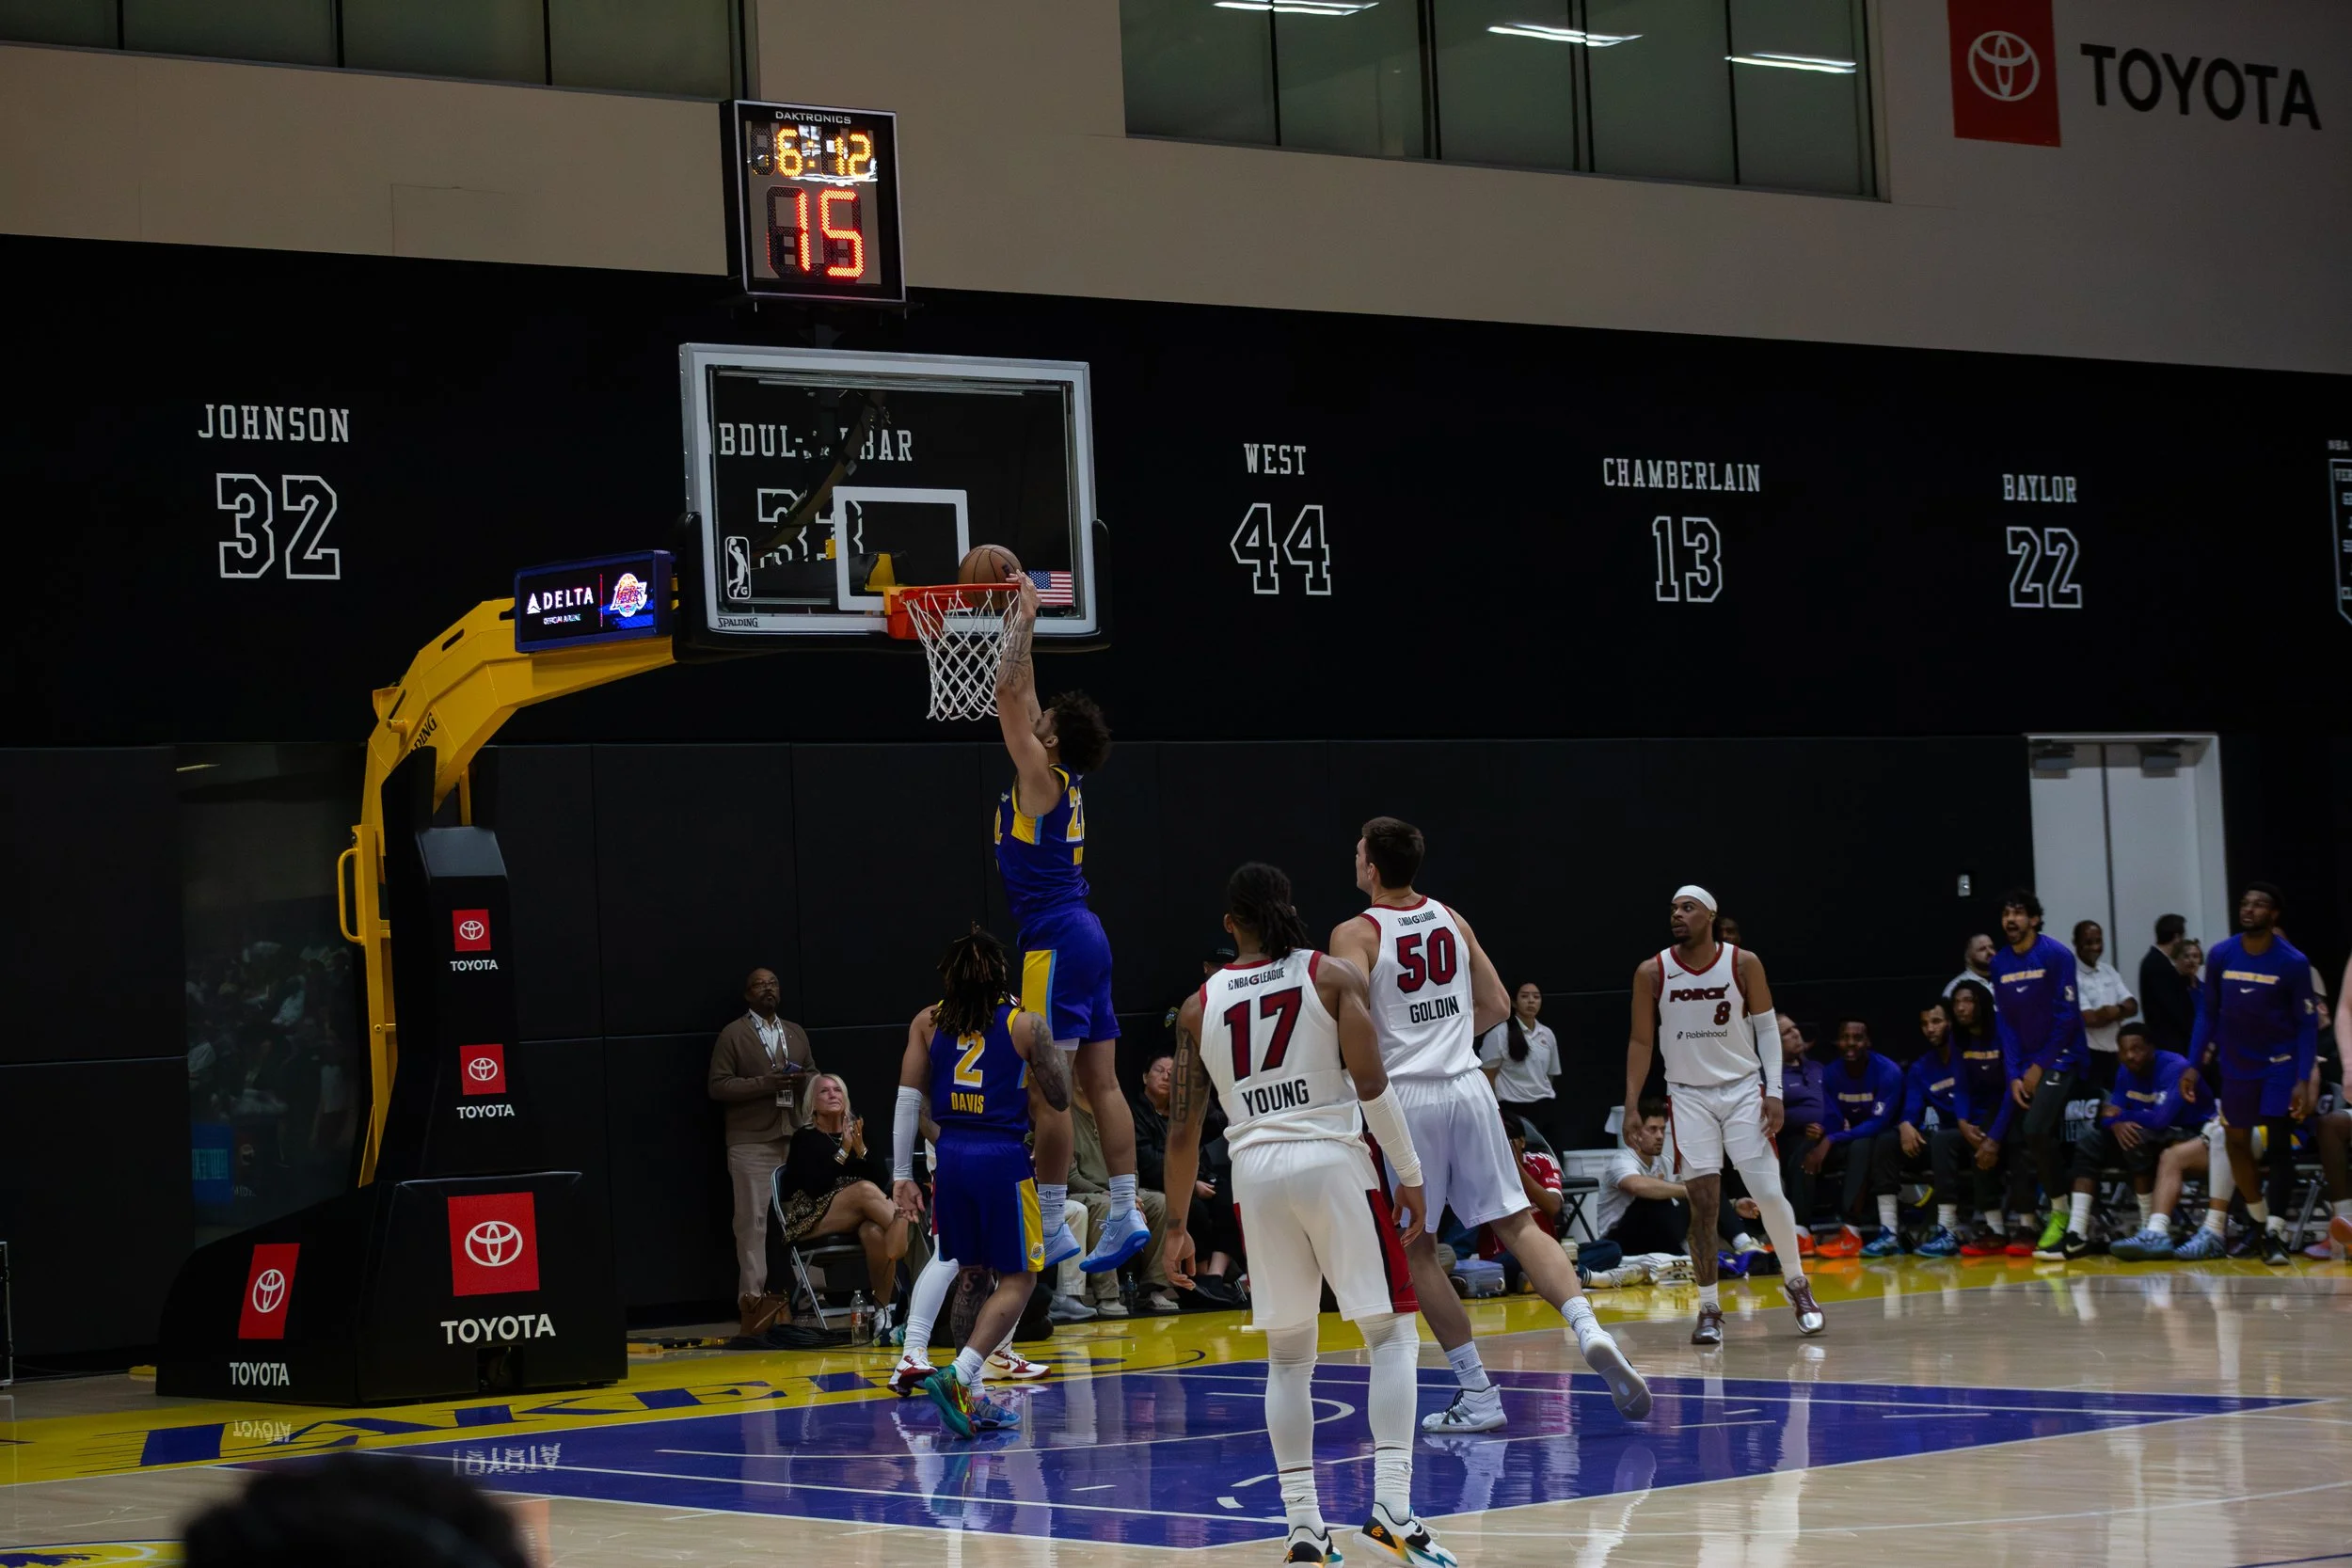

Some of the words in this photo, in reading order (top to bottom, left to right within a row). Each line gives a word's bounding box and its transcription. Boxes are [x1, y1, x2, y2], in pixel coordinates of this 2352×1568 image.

[2080, 43, 2322, 131] TOYOTA
[775, 110, 851, 124] DAKTRONICS
[797, 189, 866, 278] 15
[198, 404, 350, 443] JOHNSON
[1243, 442, 1307, 476] WEST
[1603, 457, 1760, 493] CHAMBERLAIN
[2002, 473, 2077, 503] BAYLOR
[215, 472, 342, 581] 32
[1230, 502, 1332, 596] 44
[1651, 515, 1724, 603] 13
[2006, 526, 2083, 609] 22
[543, 587, 594, 610] DELTA
[718, 617, 759, 628] SPALDING
[450, 959, 499, 973] TOYOTA
[1396, 927, 1457, 994] 50
[1234, 976, 1248, 990] NBA
[1248, 974, 1260, 986] G
[1260, 967, 1285, 983] LEAGUE
[1409, 996, 1460, 1023] GOLDIN
[1713, 1001, 1731, 1025] 8
[1223, 986, 1303, 1081] 17
[1685, 1030, 1728, 1039] Robinhood
[953, 1030, 986, 1088] 2
[456, 1103, 516, 1119] TOYOTA
[950, 1092, 985, 1114] DAVIS
[1242, 1078, 1310, 1117] YOUNG
[439, 1313, 557, 1345] TOYOTA
[229, 1361, 291, 1386] TOYOTA
